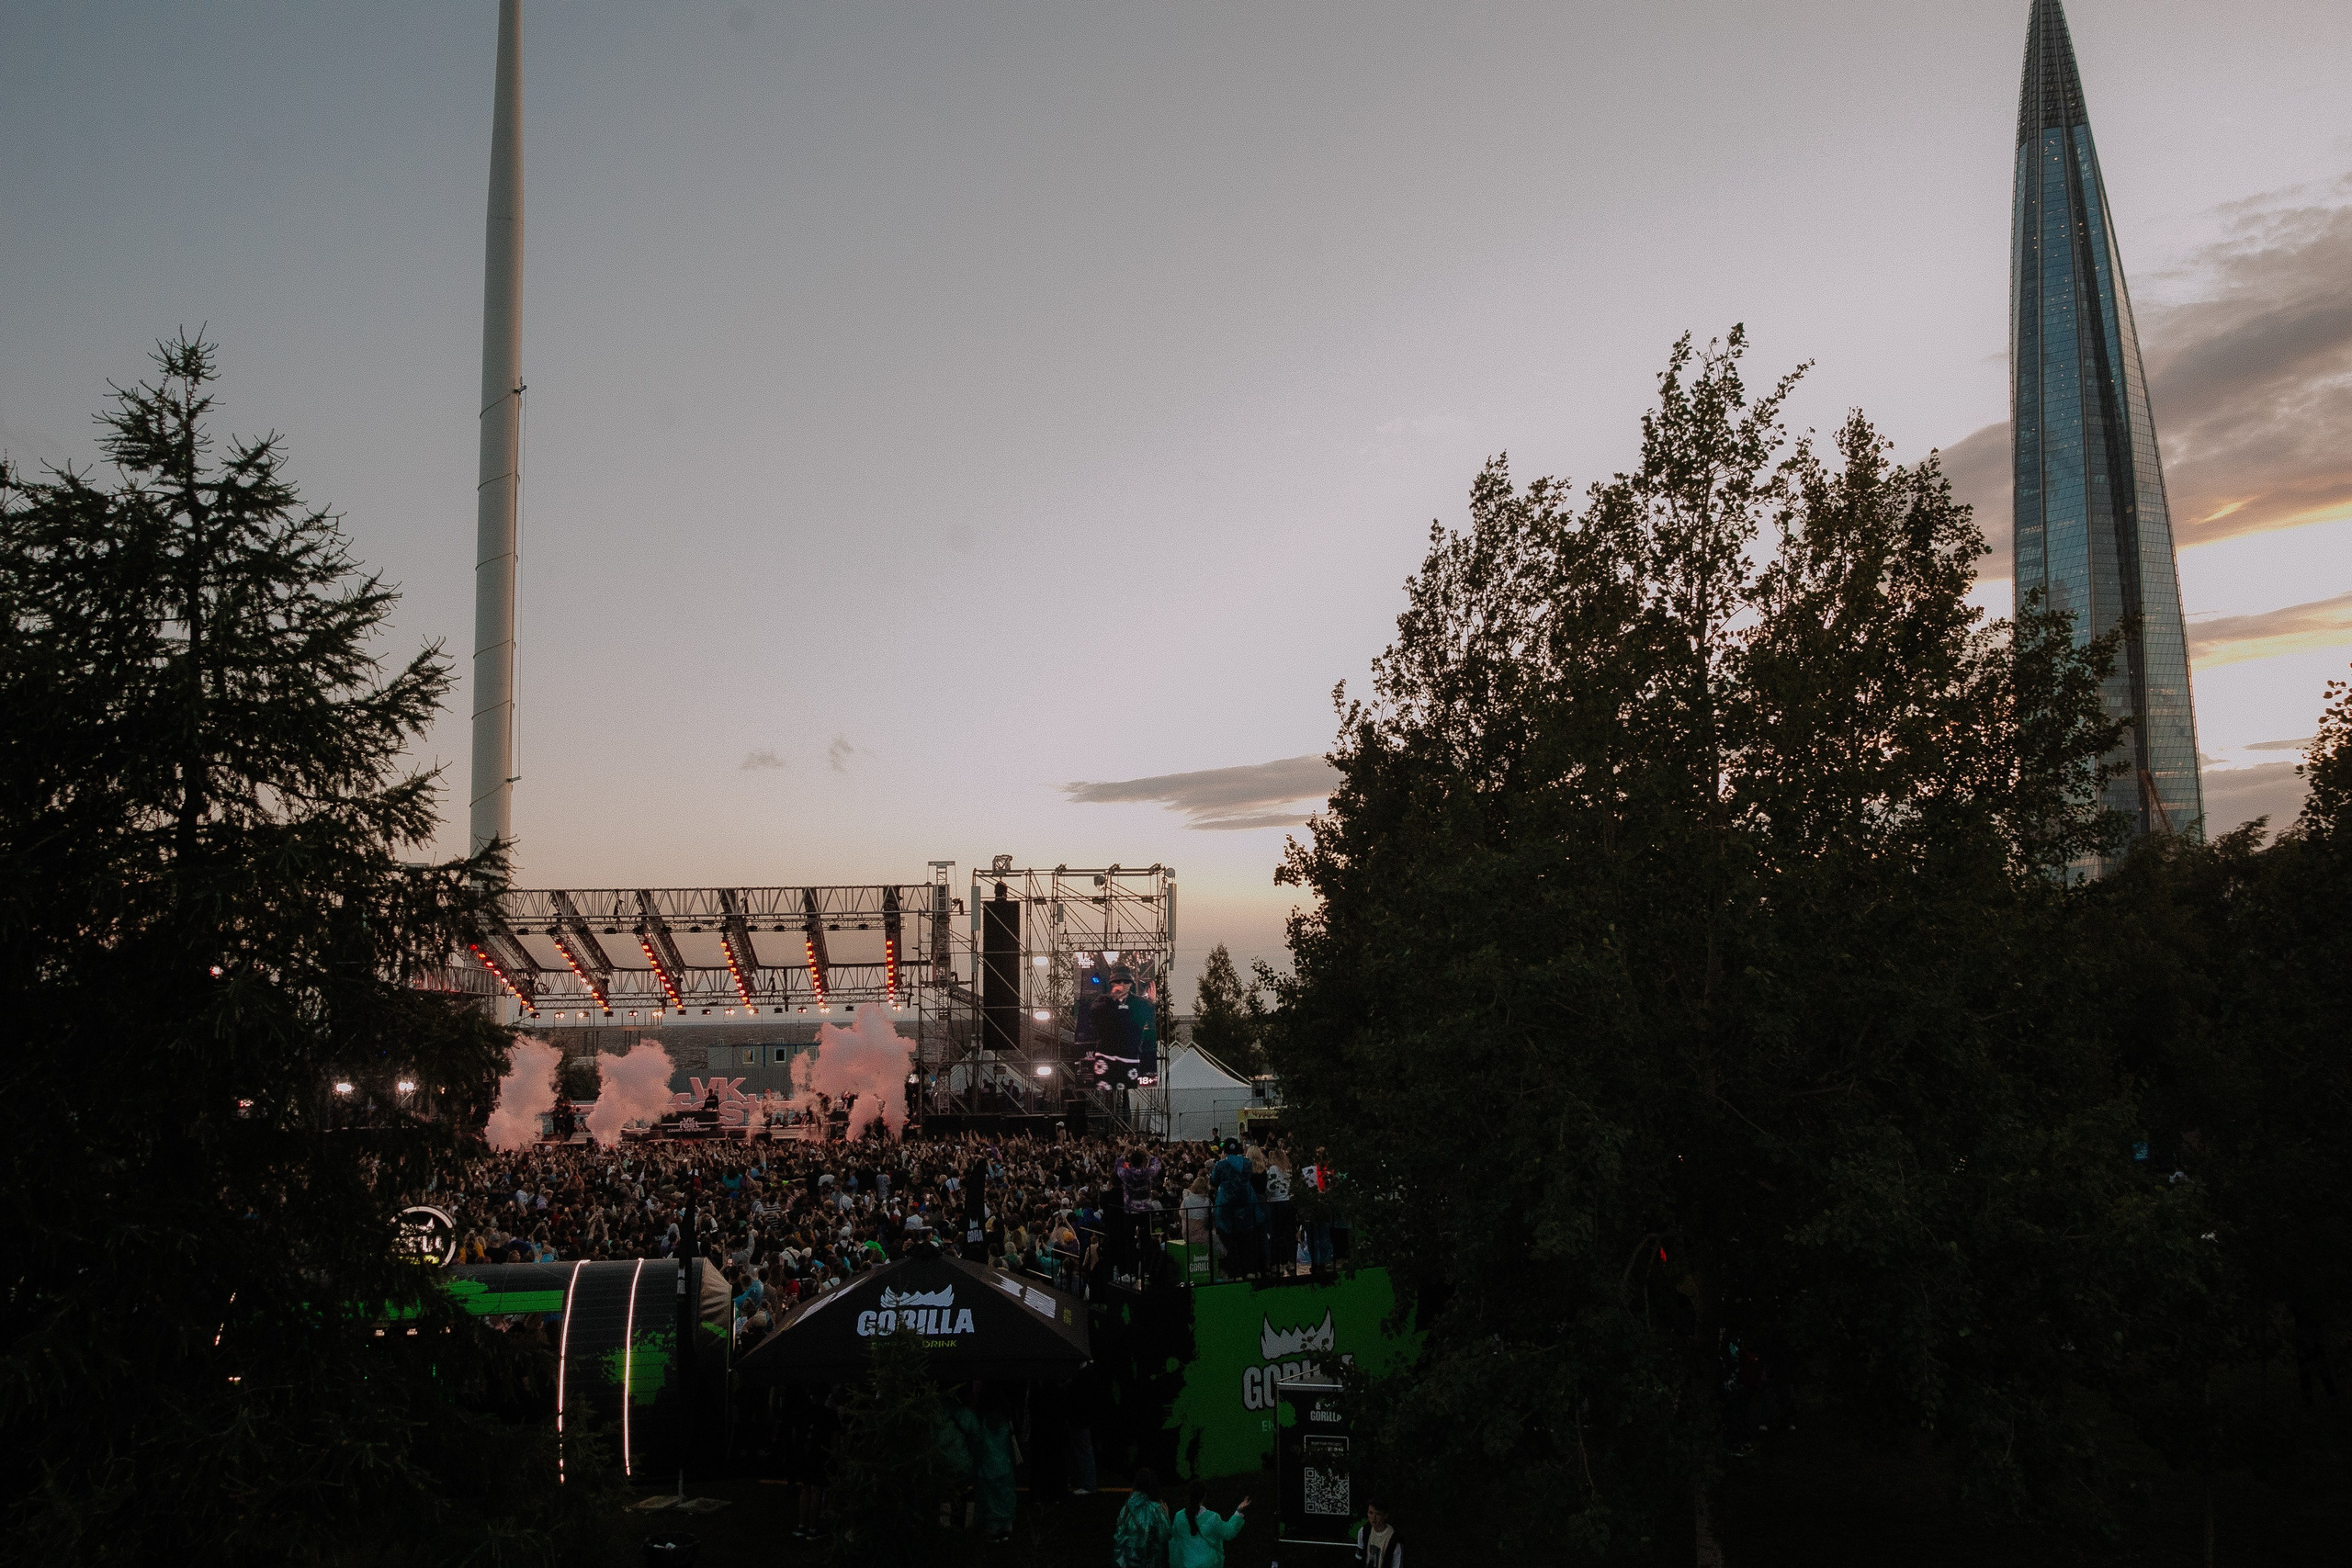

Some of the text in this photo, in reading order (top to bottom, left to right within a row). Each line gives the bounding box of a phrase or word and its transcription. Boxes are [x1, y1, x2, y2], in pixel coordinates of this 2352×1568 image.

[689, 1077, 748, 1101] VK
[1189, 1261, 1210, 1273] GORILL
[922, 1339, 957, 1348] DRINK
